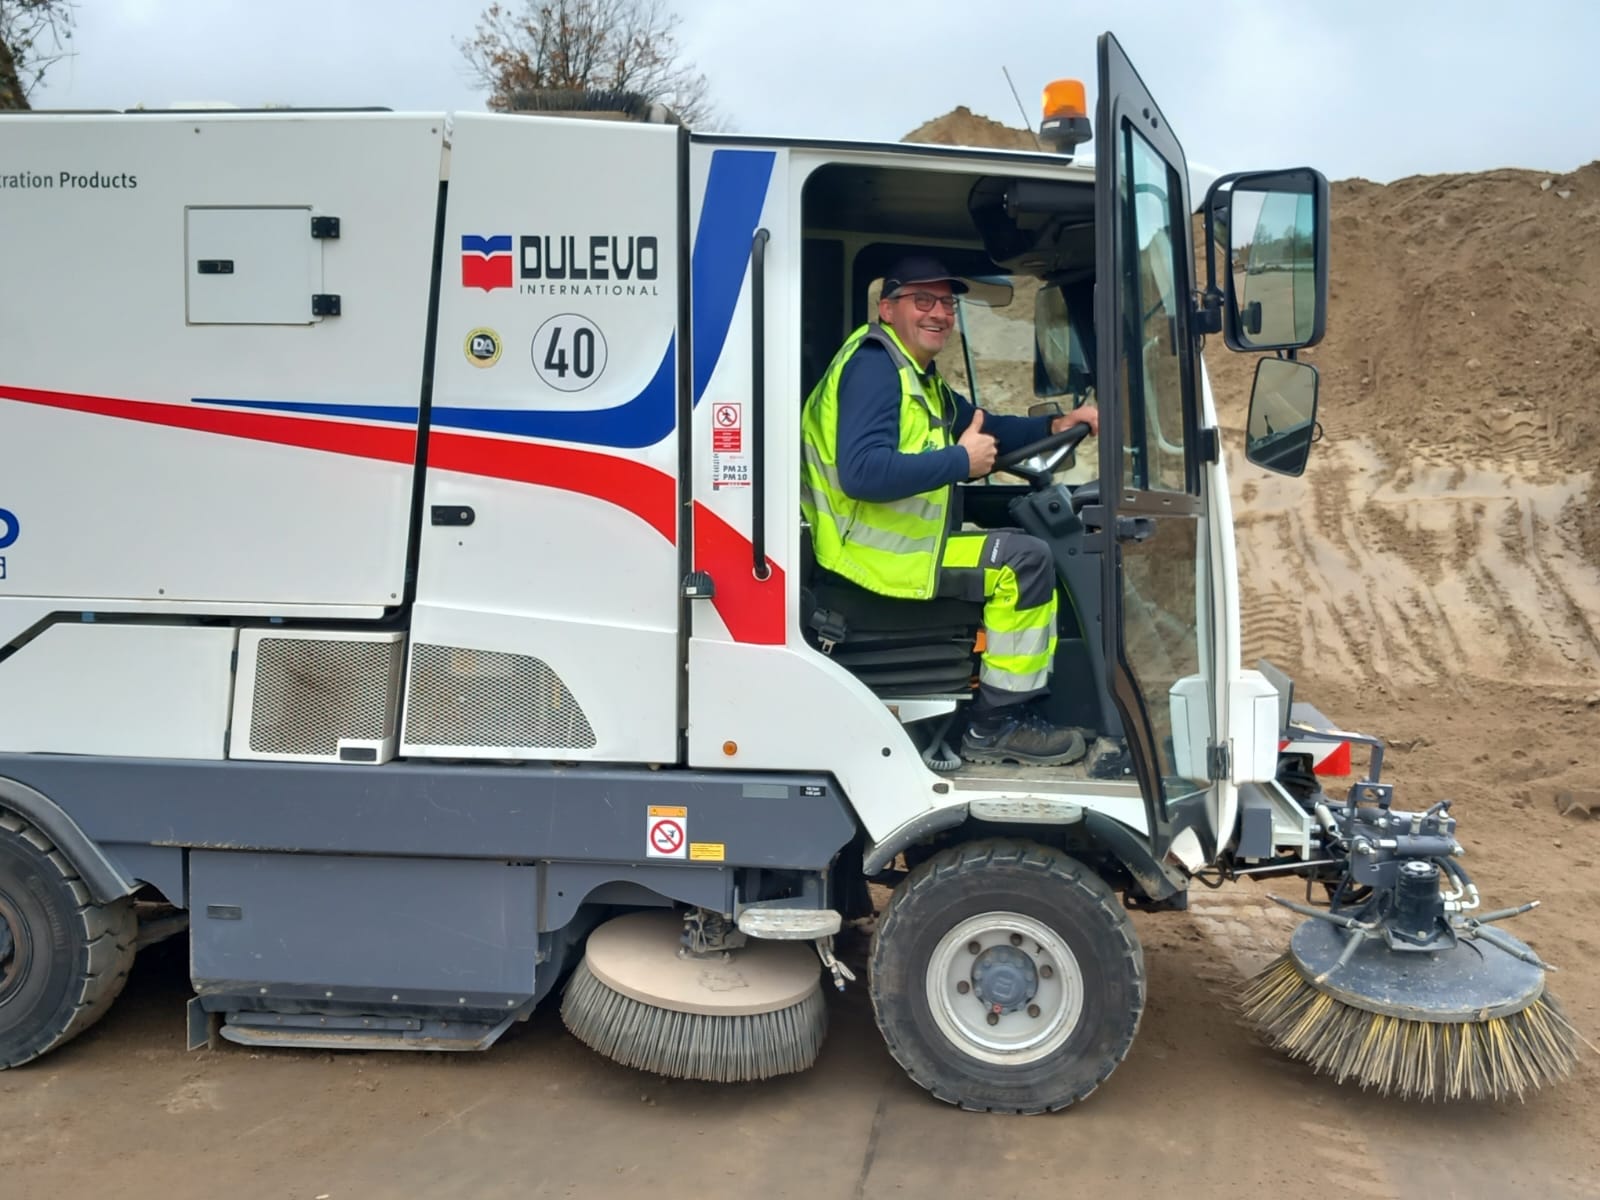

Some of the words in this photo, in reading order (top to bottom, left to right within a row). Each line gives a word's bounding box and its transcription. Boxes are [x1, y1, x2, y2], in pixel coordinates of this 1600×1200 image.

[60, 171, 137, 188] Products
[520, 235, 658, 280] DULEVO
[520, 284, 658, 296] INTERNATIONAL
[544, 327, 595, 378] 40
